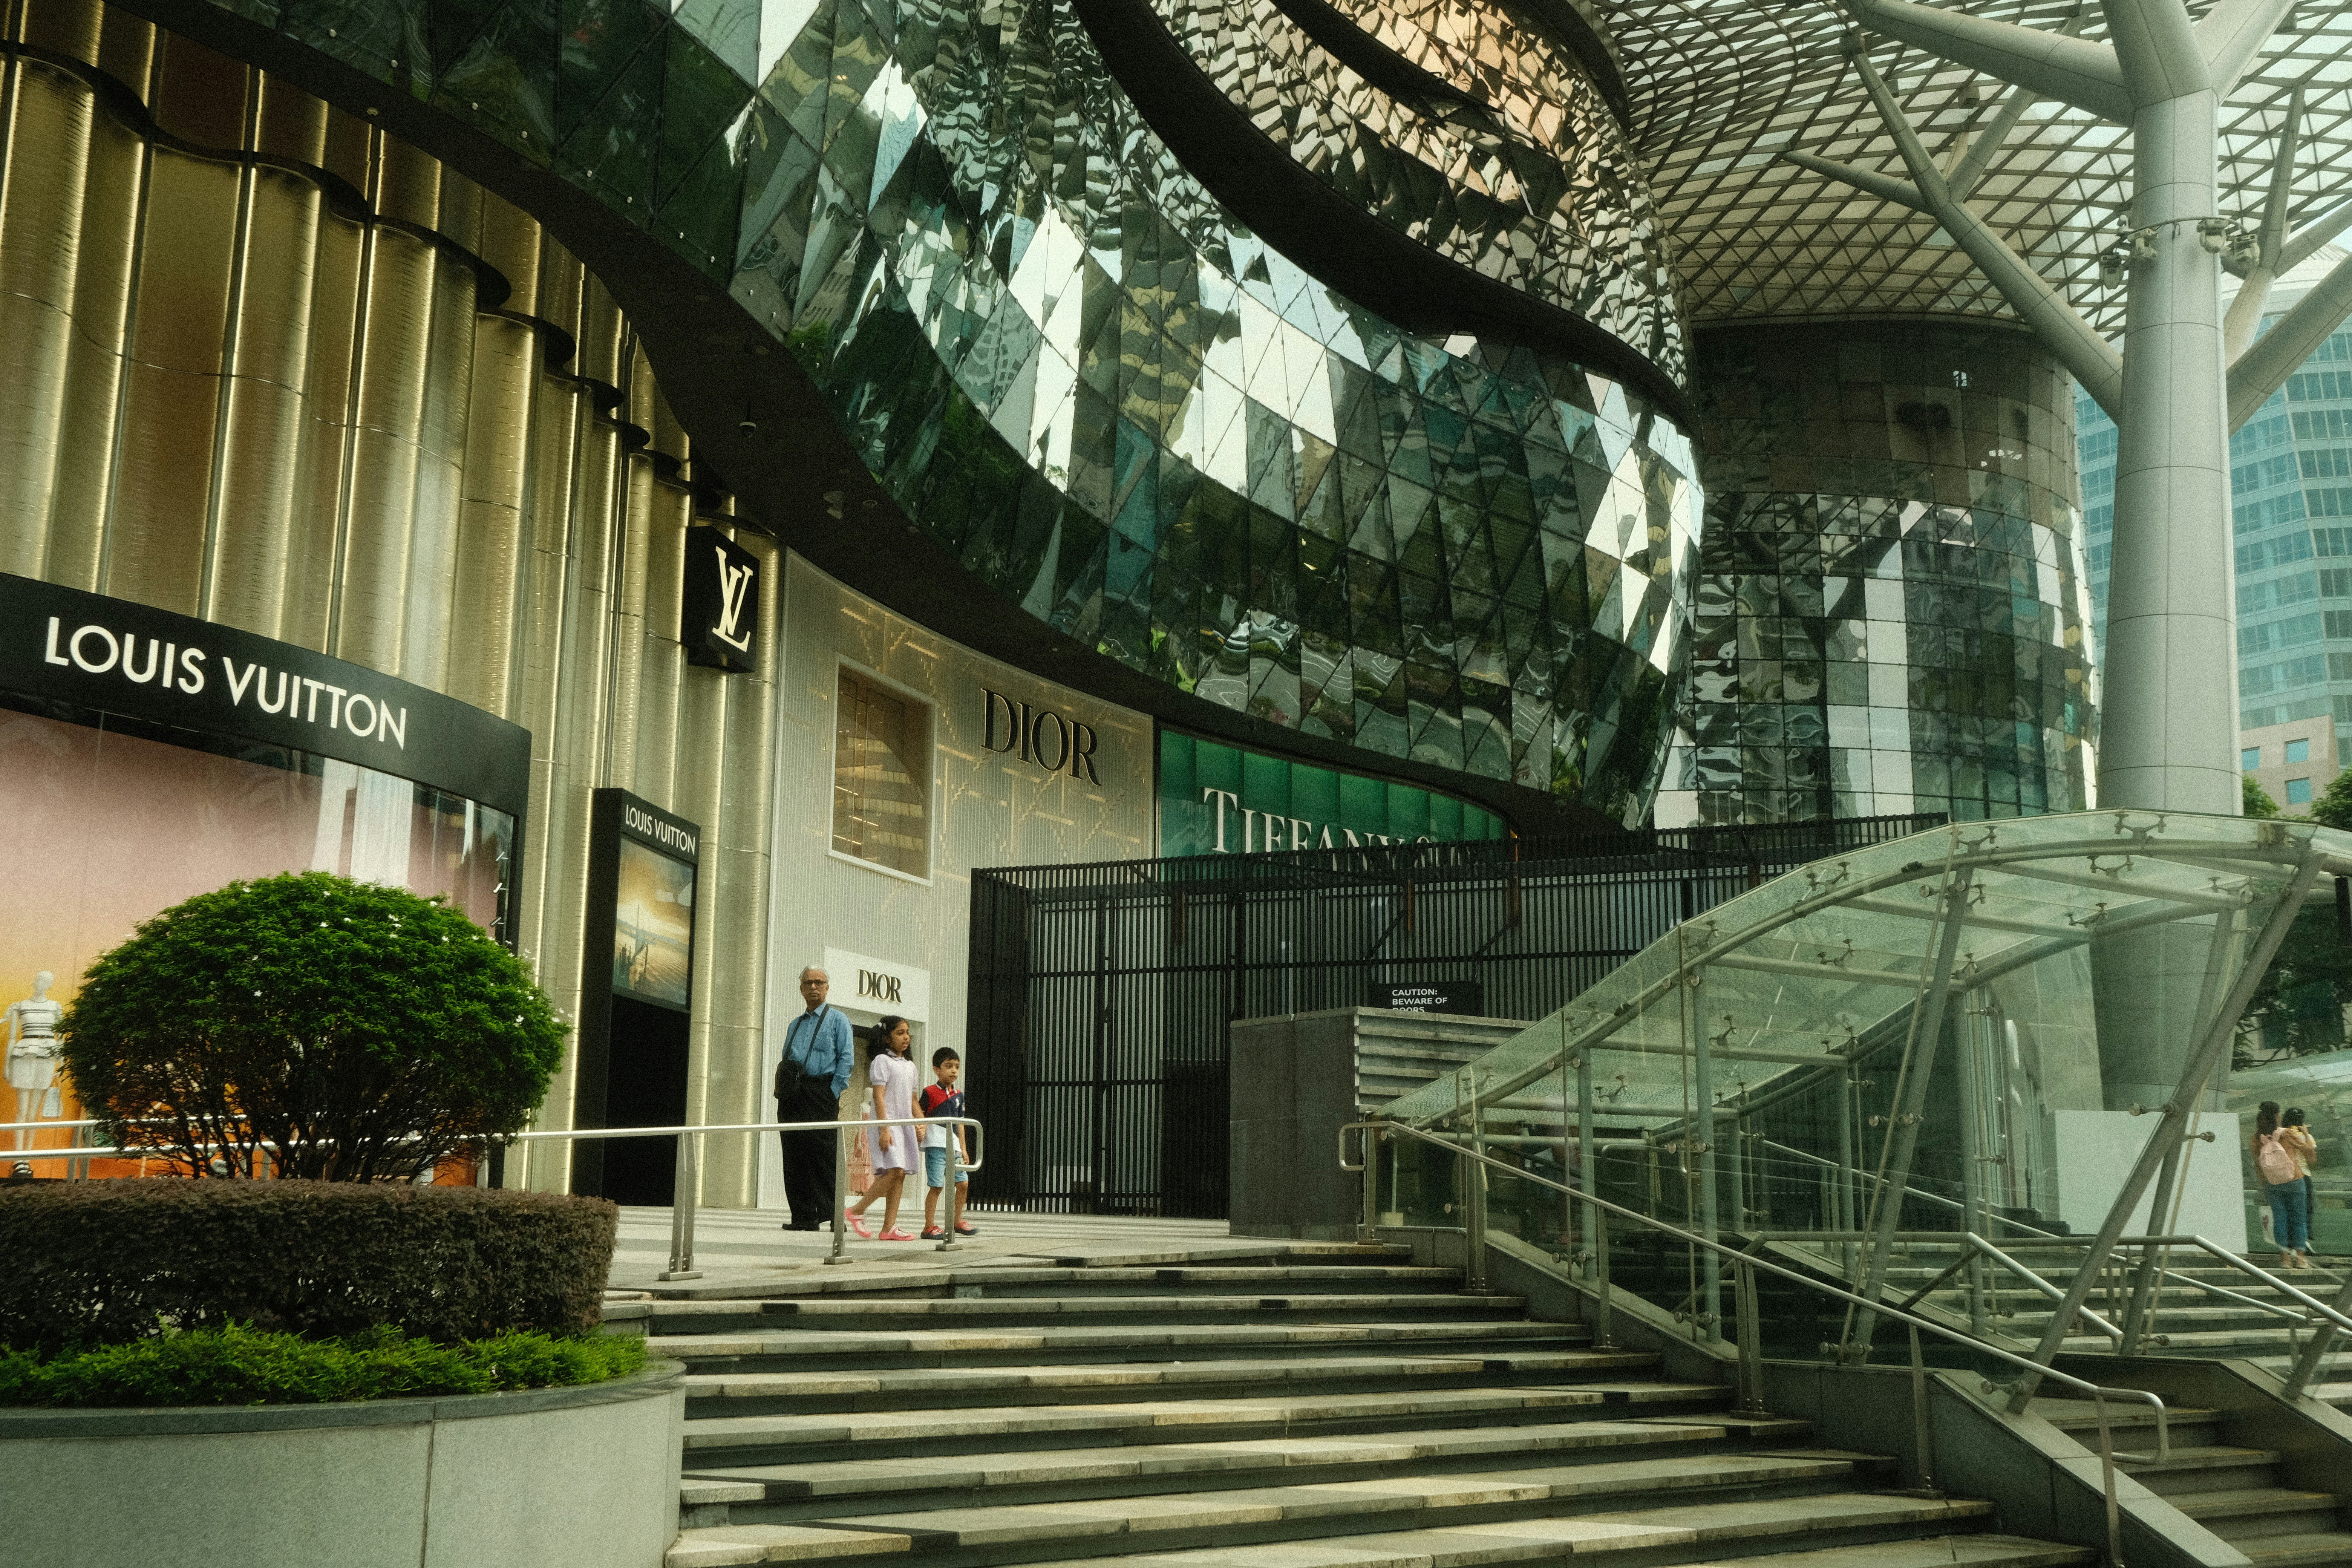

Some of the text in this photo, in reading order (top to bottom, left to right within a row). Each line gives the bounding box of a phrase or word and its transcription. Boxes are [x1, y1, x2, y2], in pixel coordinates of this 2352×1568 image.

[45, 616, 407, 750] LOUIS VUITTON
[980, 688, 1101, 786] DIOR
[625, 804, 695, 856] LOUIS VUITTON
[857, 969, 902, 1003] DIOR
